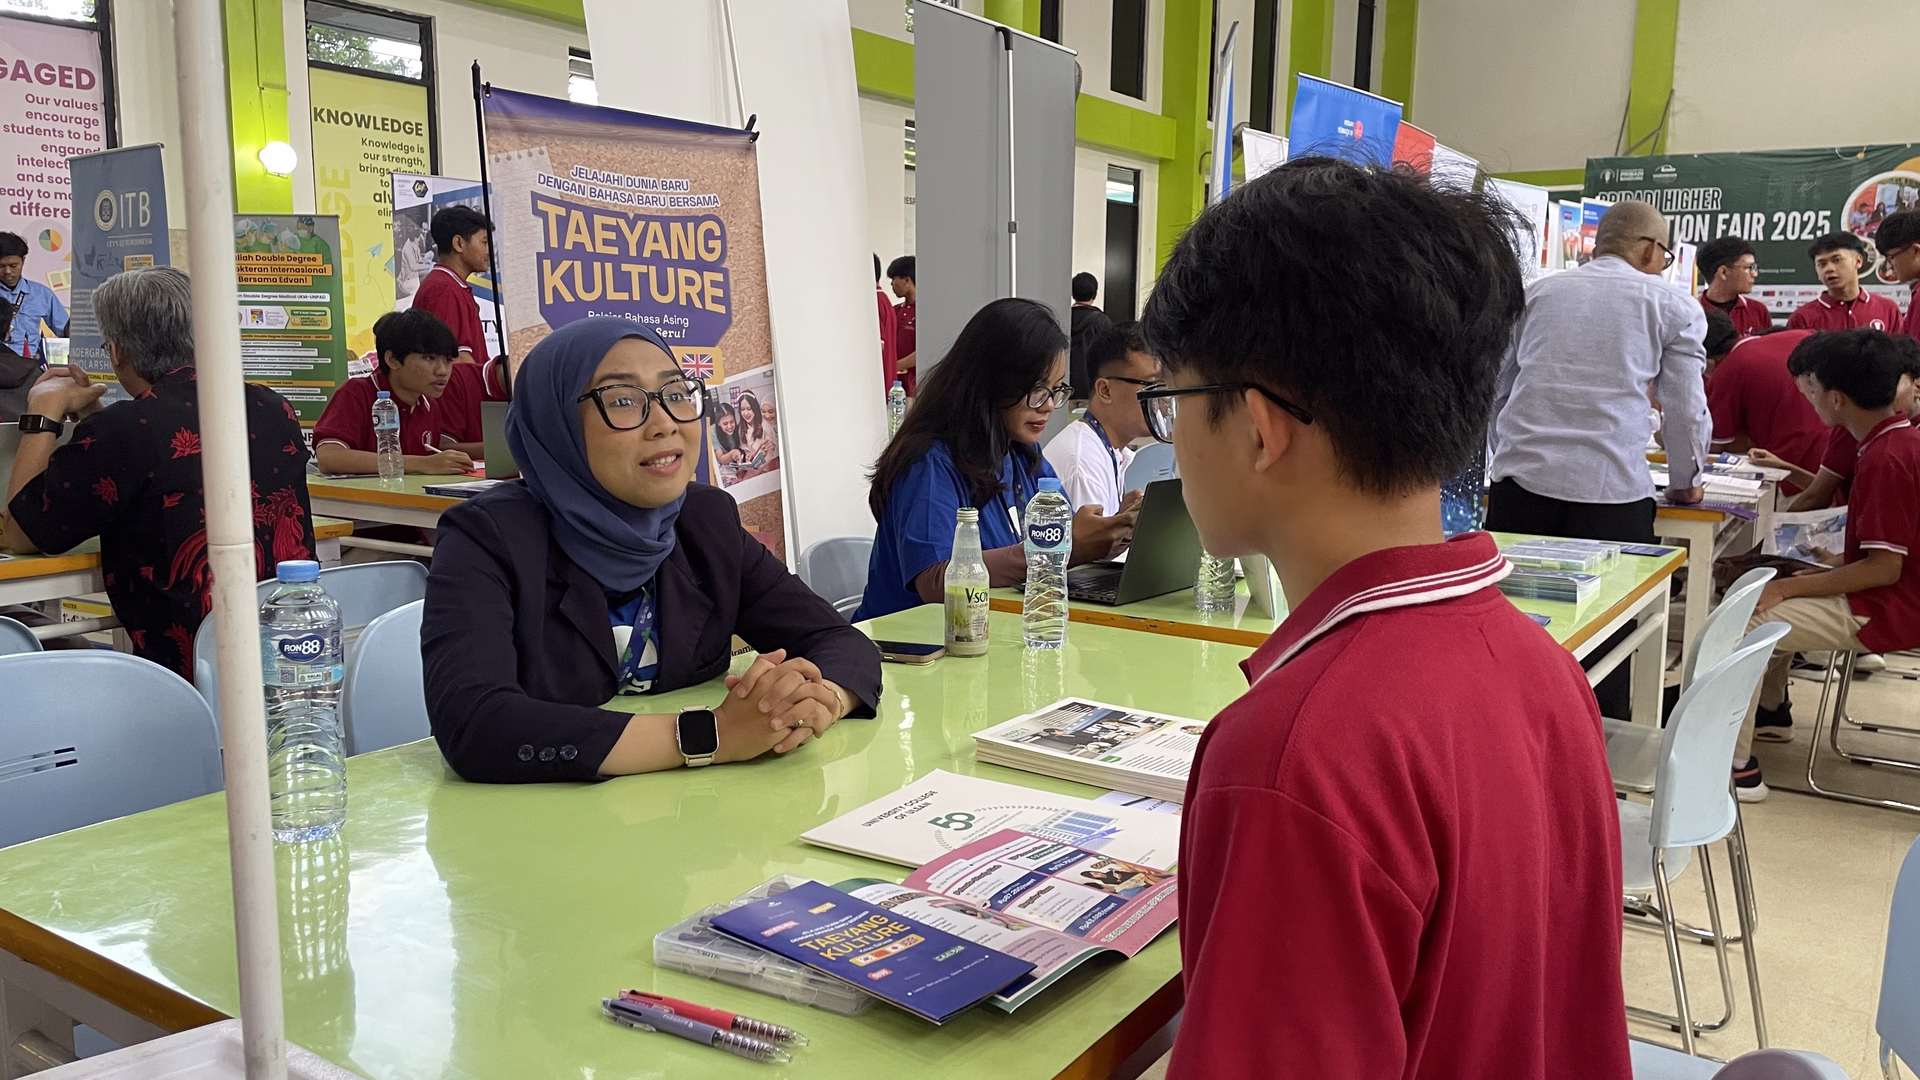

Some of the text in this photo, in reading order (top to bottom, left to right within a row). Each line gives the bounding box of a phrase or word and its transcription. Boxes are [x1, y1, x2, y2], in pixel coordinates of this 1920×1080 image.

[25, 93, 98, 111] Our values
[25, 110, 99, 129] encourage
[313, 107, 423, 137] KNOWLEDGE
[3, 123, 100, 141] students to be
[361, 137, 425, 154] Knowledge is
[17, 154, 69, 169] intelect
[363, 152, 426, 168] our strength,
[16, 173, 71, 185] and soc
[359, 163, 391, 177] brings
[571, 165, 689, 191] JELAJAHI DUNIA BARU
[380, 179, 390, 188] to
[537, 173, 720, 208] DENGAN BAHASA BARU BERSAMA
[0, 187, 33, 201] eady
[37, 189, 51, 199] to
[1662, 187, 1722, 212] HIGHER
[9, 201, 71, 219] differe
[120, 191, 151, 229] ITB
[537, 200, 722, 262] TAEYANG
[1664, 210, 1831, 242] TION FAIR 2025
[255, 254, 285, 262] Double
[286, 255, 317, 264] Degree
[270, 266, 327, 274] Internasional
[542, 259, 727, 314] KULTURE
[625, 312, 660, 324] Bahasa
[663, 314, 689, 328] Asing
[655, 327, 686, 339] Seru!
[798, 914, 889, 950] TAEYANG
[819, 921, 911, 961] KULTURE
